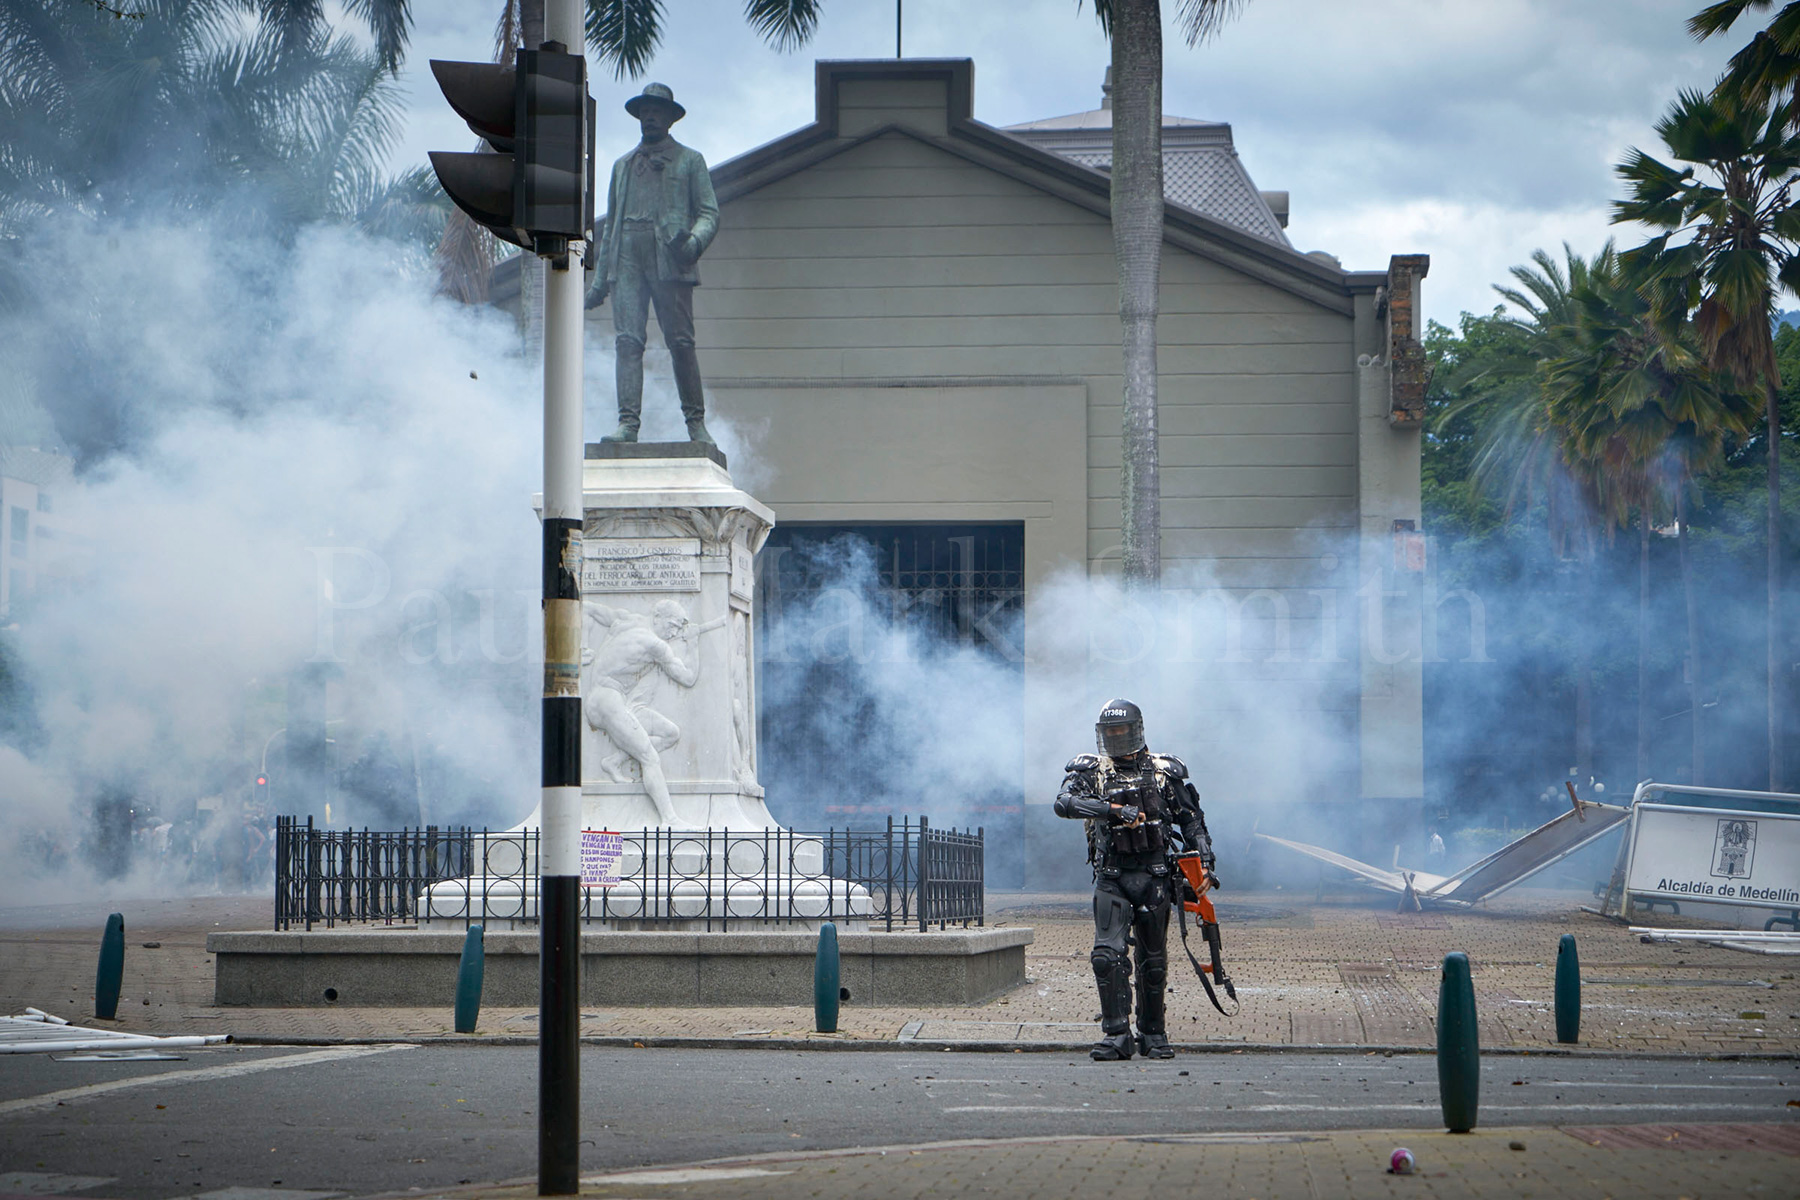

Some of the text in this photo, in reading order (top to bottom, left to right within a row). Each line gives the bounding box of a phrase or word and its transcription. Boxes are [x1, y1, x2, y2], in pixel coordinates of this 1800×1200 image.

[598, 547, 639, 556] FRANCISCO
[647, 546, 682, 555] CISNEROS
[585, 570, 695, 580] DEL FERROCARRIL DE ANTIOQUIA
[582, 834, 609, 842] VENGAN
[1657, 878, 1799, 902] Alcaldía de Medellín
